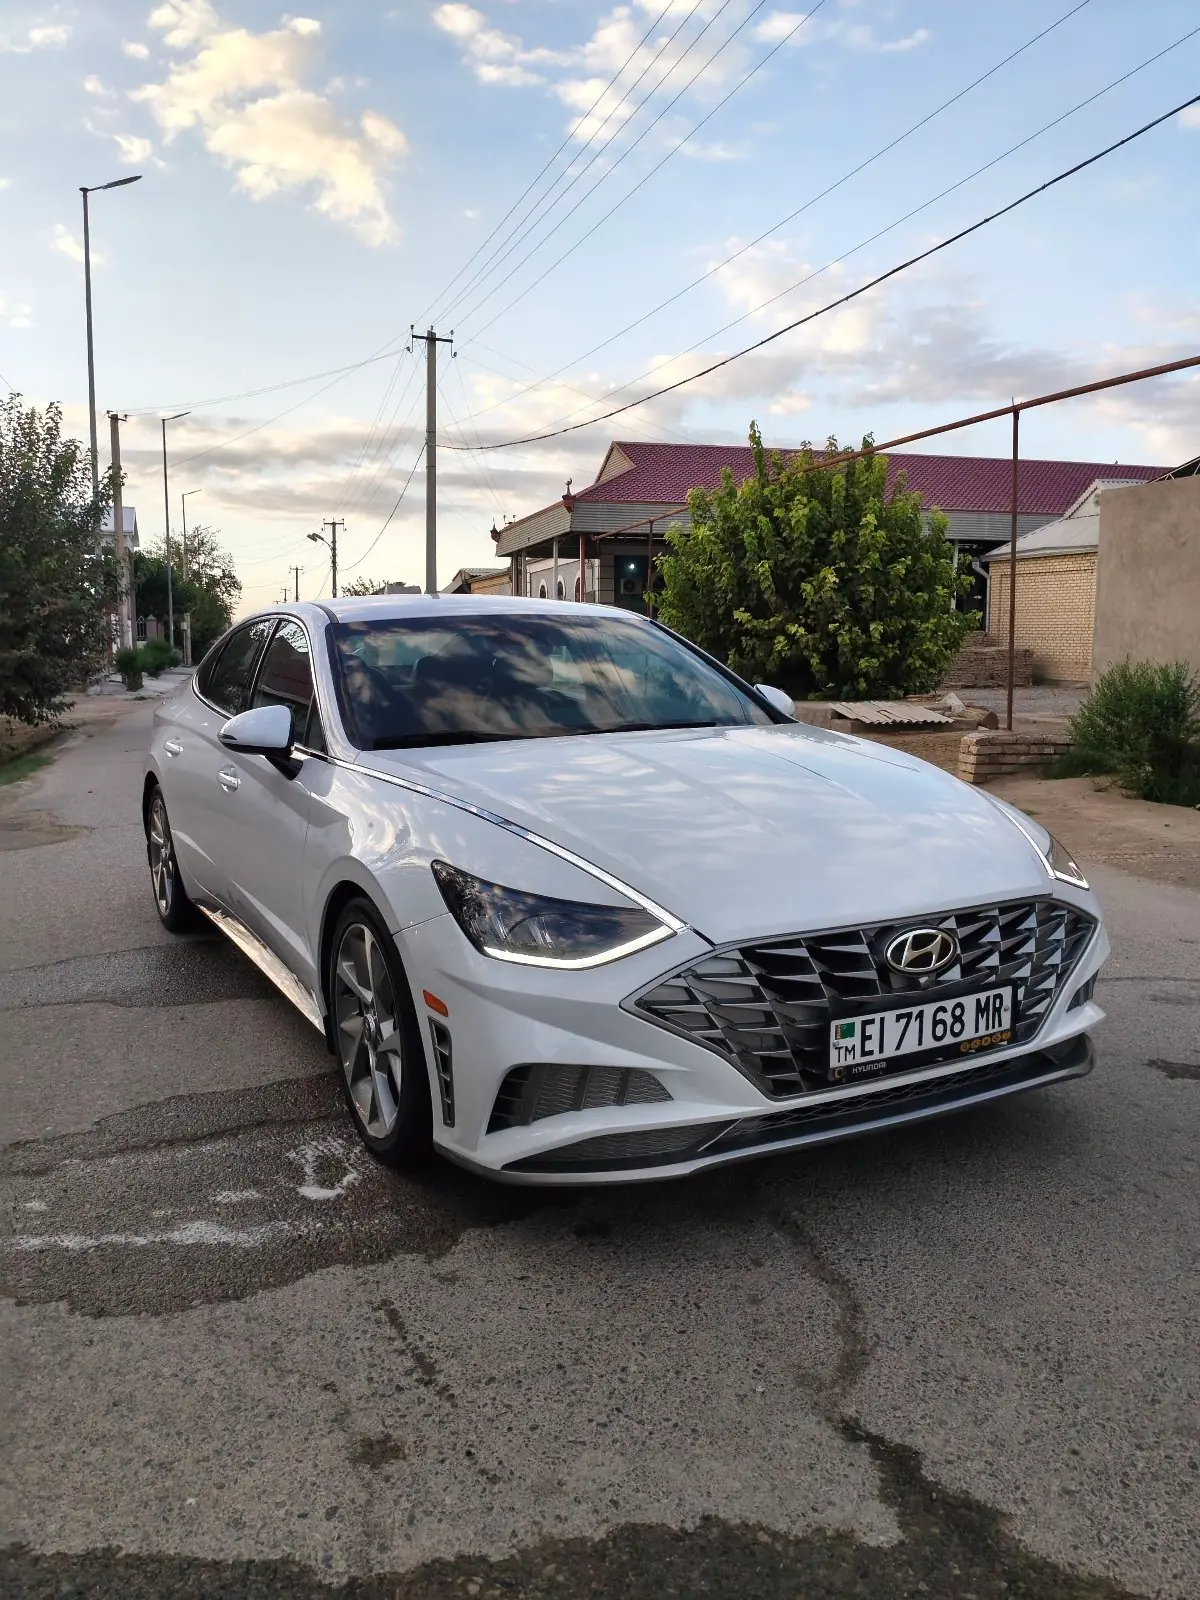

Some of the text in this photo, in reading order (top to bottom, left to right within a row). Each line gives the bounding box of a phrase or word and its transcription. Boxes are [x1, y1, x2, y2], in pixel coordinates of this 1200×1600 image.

[860, 992, 1004, 1057] EI 7168 MR
[835, 1043, 856, 1063] TM
[852, 1061, 887, 1074] HYUNDAI
